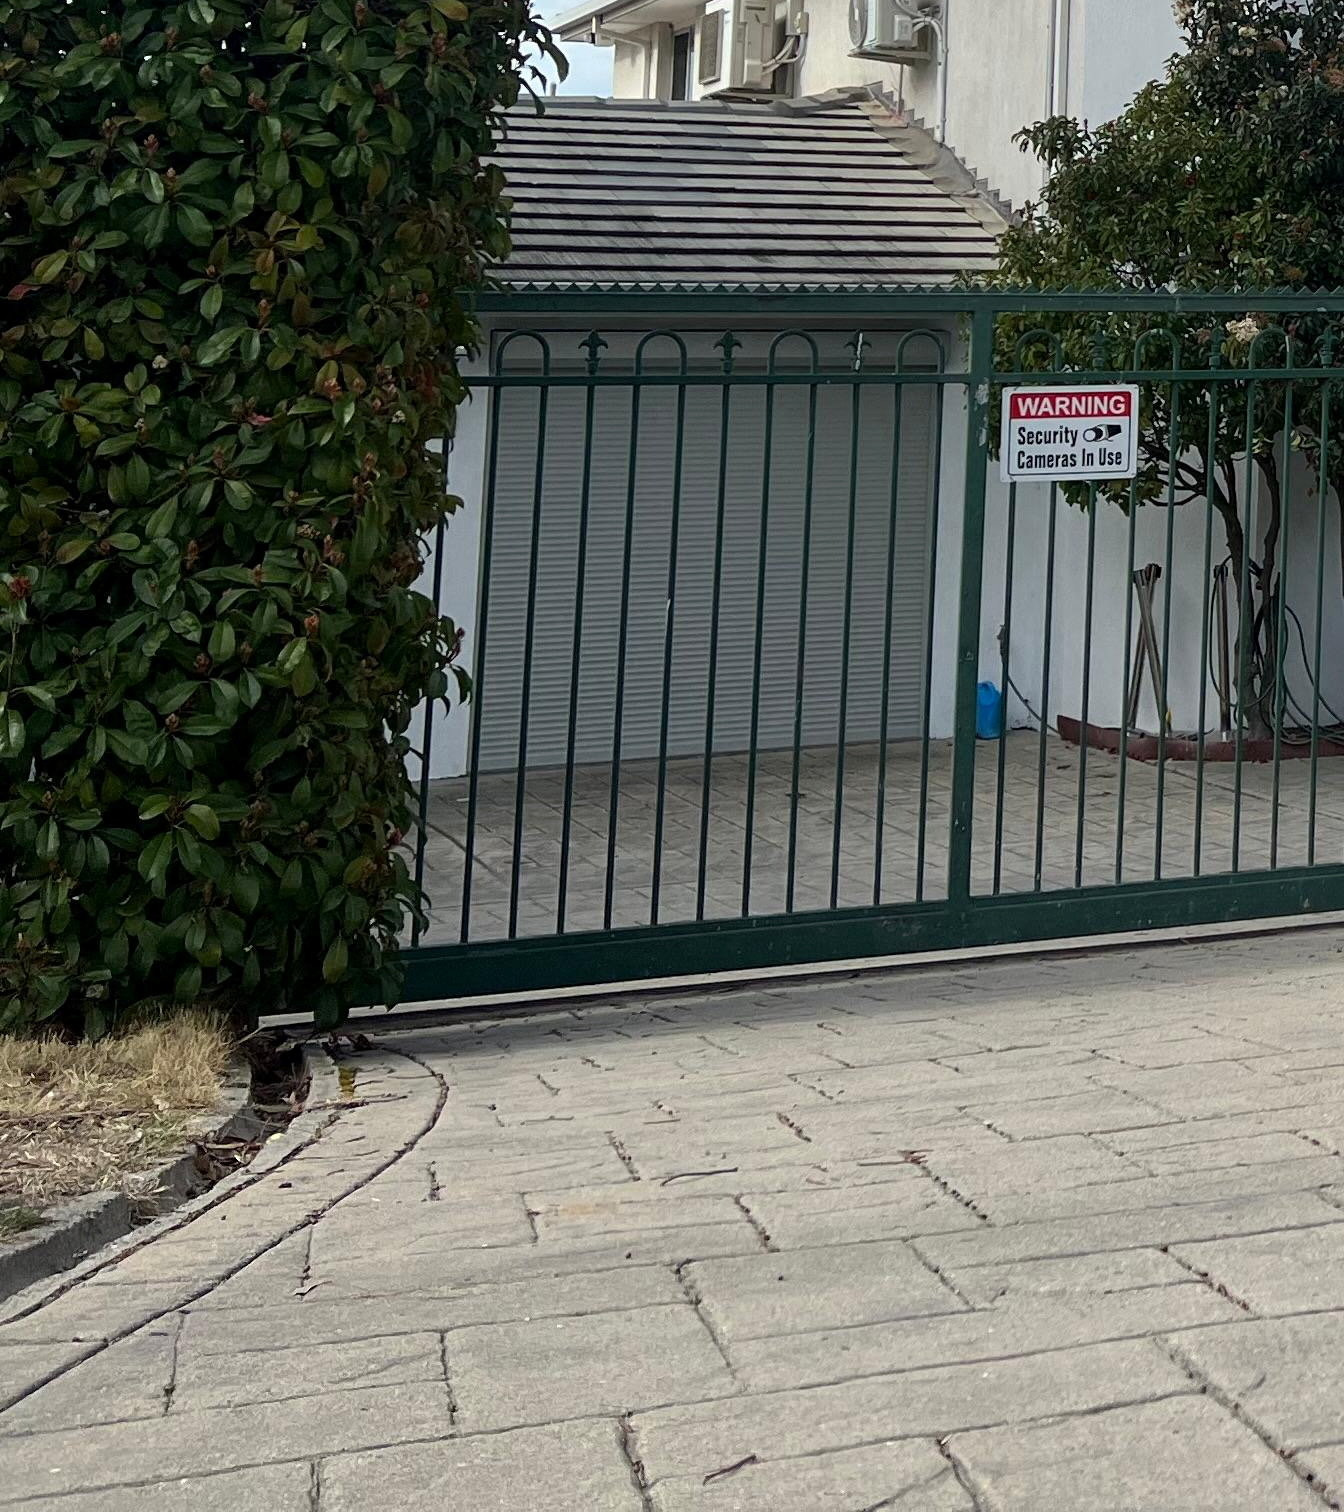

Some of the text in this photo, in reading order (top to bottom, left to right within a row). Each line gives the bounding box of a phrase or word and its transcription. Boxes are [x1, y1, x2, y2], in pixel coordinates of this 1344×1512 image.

[1017, 395, 1126, 417] WARNING
[1017, 425, 1079, 448] Security
[1017, 447, 1122, 470] Cameras In Use
